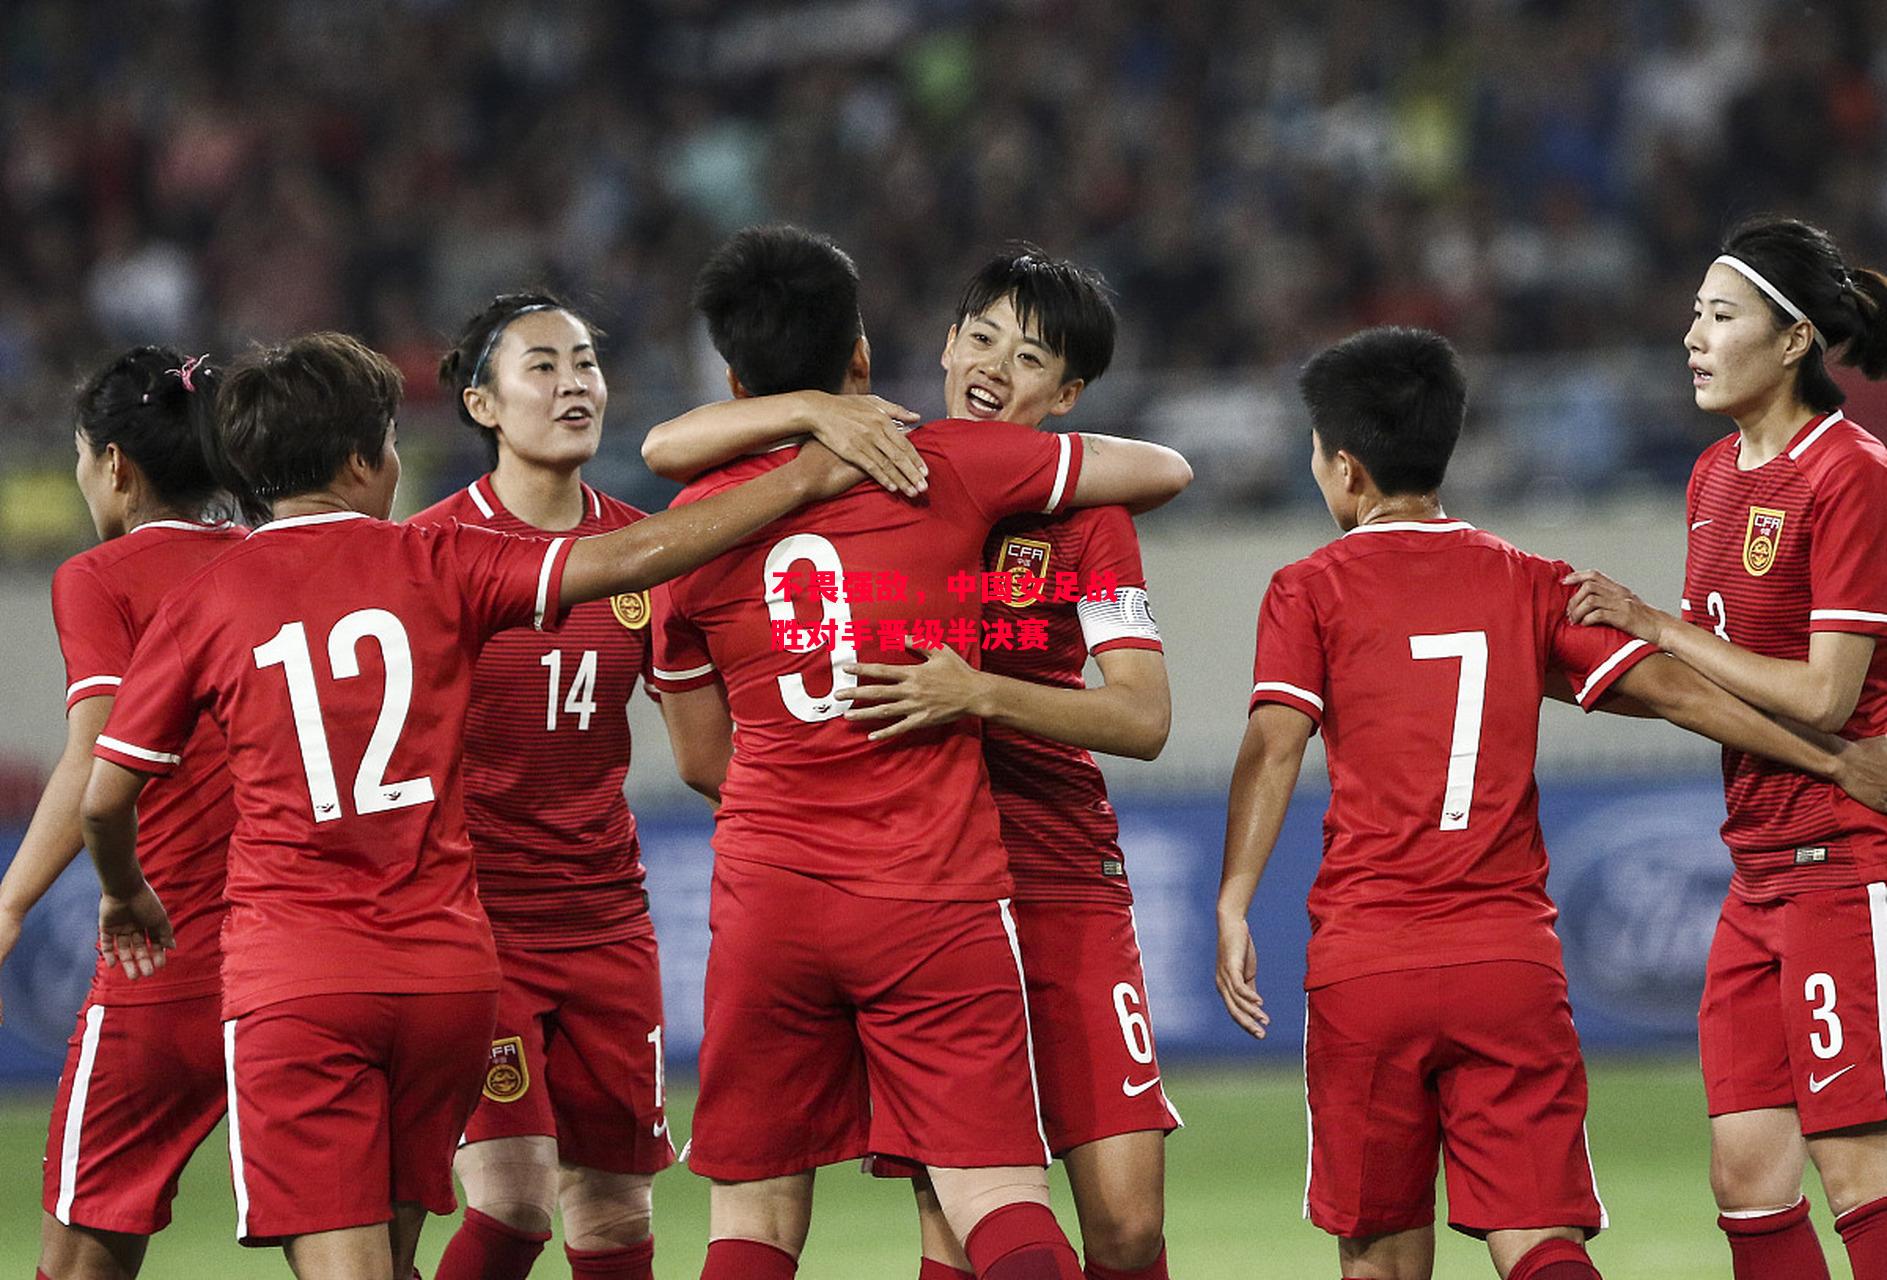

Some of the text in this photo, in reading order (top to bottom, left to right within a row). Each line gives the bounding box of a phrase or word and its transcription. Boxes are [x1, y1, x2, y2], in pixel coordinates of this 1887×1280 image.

[1007, 544, 1044, 561] CFA
[1755, 514, 1782, 530] CFA
[763, 533, 860, 723] 9
[252, 608, 435, 823] 12
[540, 648, 598, 731] 14
[1408, 630, 1489, 831] 7
[489, 1044, 516, 1059] FA
[1112, 982, 1153, 1064] 6
[1804, 972, 1844, 1060] 3
